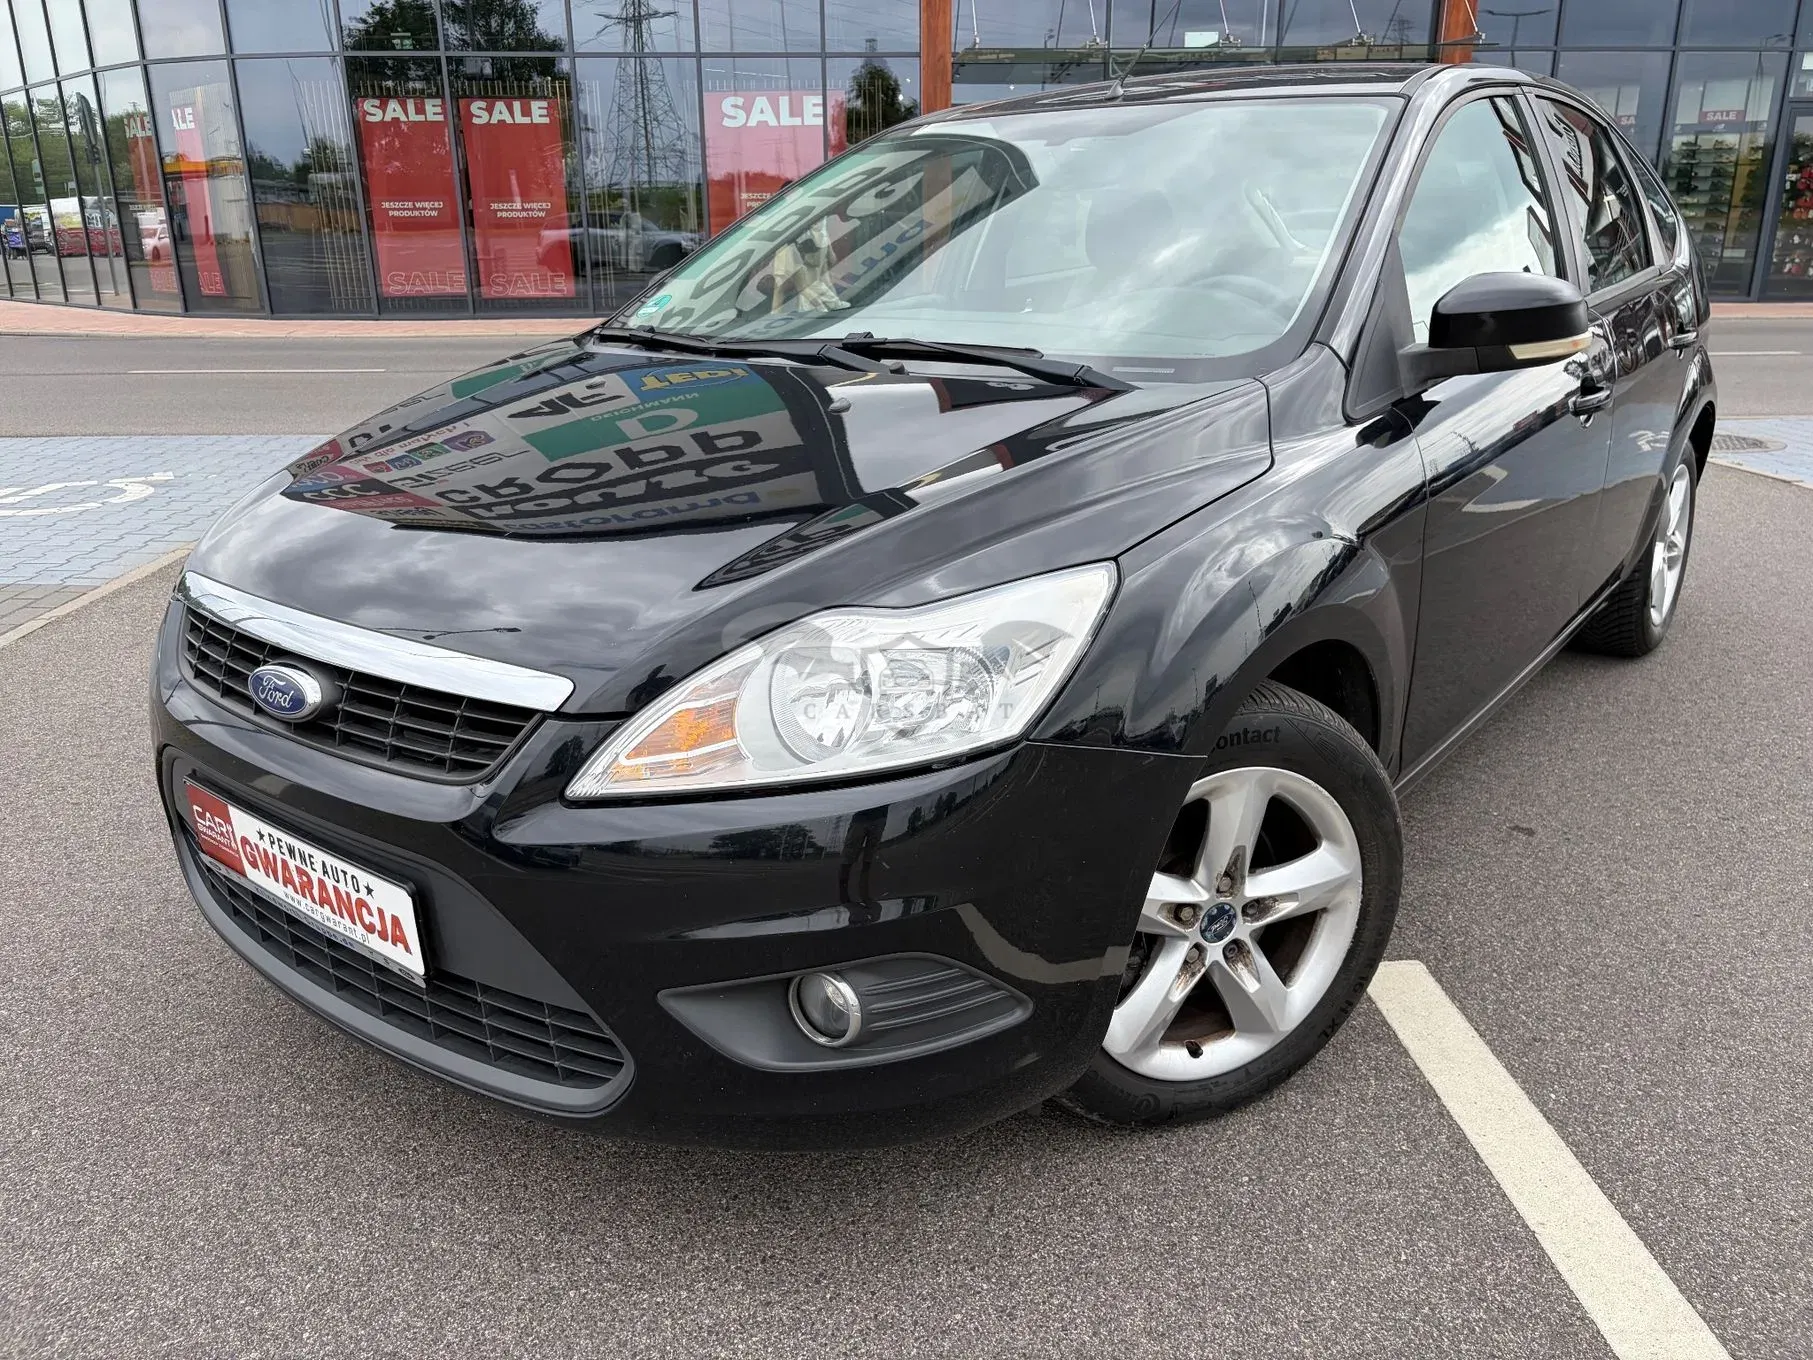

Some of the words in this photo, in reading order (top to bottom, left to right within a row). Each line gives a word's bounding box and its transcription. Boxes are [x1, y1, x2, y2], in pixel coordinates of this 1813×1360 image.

[364, 98, 444, 122] SALE
[470, 100, 550, 125] SALE
[721, 95, 823, 128] SALE
[1706, 111, 1737, 121] SALE
[381, 201, 414, 209] JESZCZE
[415, 201, 444, 211] WIĘCEJ
[388, 208, 439, 217] PRODUKTÓW
[490, 202, 522, 210] JESZCZE
[523, 202, 552, 211] WIĘCEJ
[496, 209, 546, 218] PRODUKTÓW
[388, 271, 468, 295] SALE
[490, 272, 567, 296] SALE
[258, 675, 293, 709] Ford
[1211, 726, 1281, 753] ontact
[192, 805, 229, 837] CAR
[269, 832, 317, 871] PEWNE
[321, 860, 361, 894] AUTO
[240, 836, 413, 955] GWARANCJA
[283, 889, 371, 944] www.cargwarant.pl
